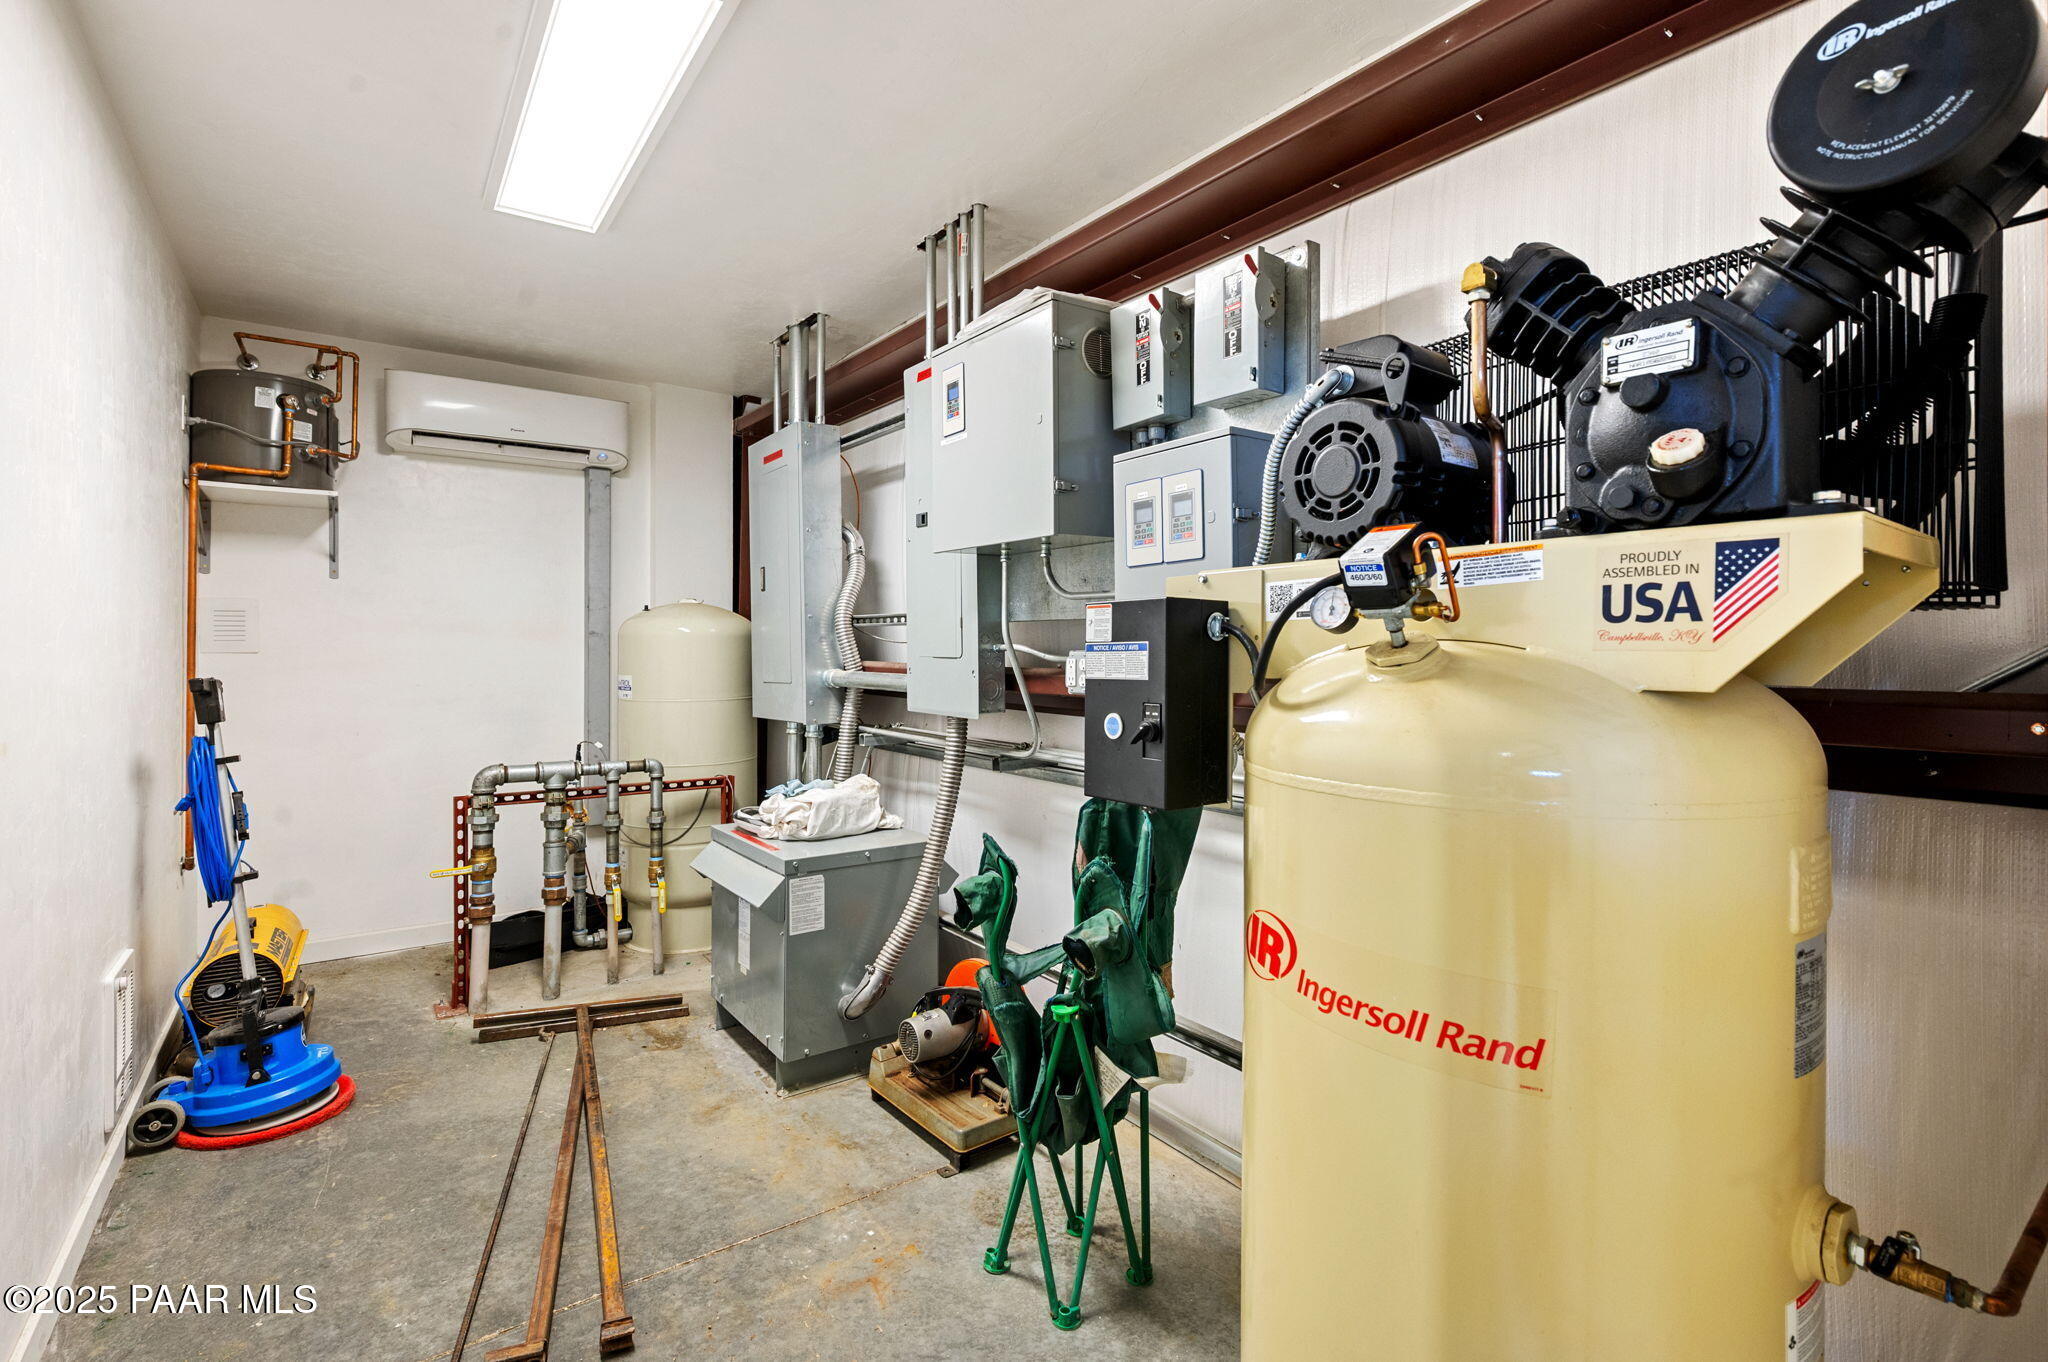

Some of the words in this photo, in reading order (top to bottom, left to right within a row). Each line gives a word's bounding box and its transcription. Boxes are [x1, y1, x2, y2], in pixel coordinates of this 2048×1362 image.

[1822, 26, 1860, 58] IR
[1865, 4, 1924, 39] Ingersoll
[1924, 0, 1957, 14] Ra
[1817, 146, 1833, 158] NOTE
[1832, 150, 1882, 161] INSTRUCTION
[1882, 137, 1919, 155] MANUAL
[1918, 124, 1937, 138] FOR
[1936, 89, 1974, 126] SERVICING
[1830, 139, 1883, 151] REPLACEMENT
[1884, 123, 1922, 145] ELEMENT
[1350, 564, 1378, 572] NOTICE
[1602, 564, 1681, 578] ASSEMBLED
[1685, 563, 1699, 574] IN
[1620, 550, 1682, 564] PROUDLY
[1350, 573, 1383, 581] 460/3/60
[1602, 581, 1703, 624] USA
[1668, 628, 1705, 645] KY
[1248, 911, 1284, 980] IR
[1296, 968, 1430, 1043] Ingersoll
[1435, 1019, 1546, 1071] Rand
